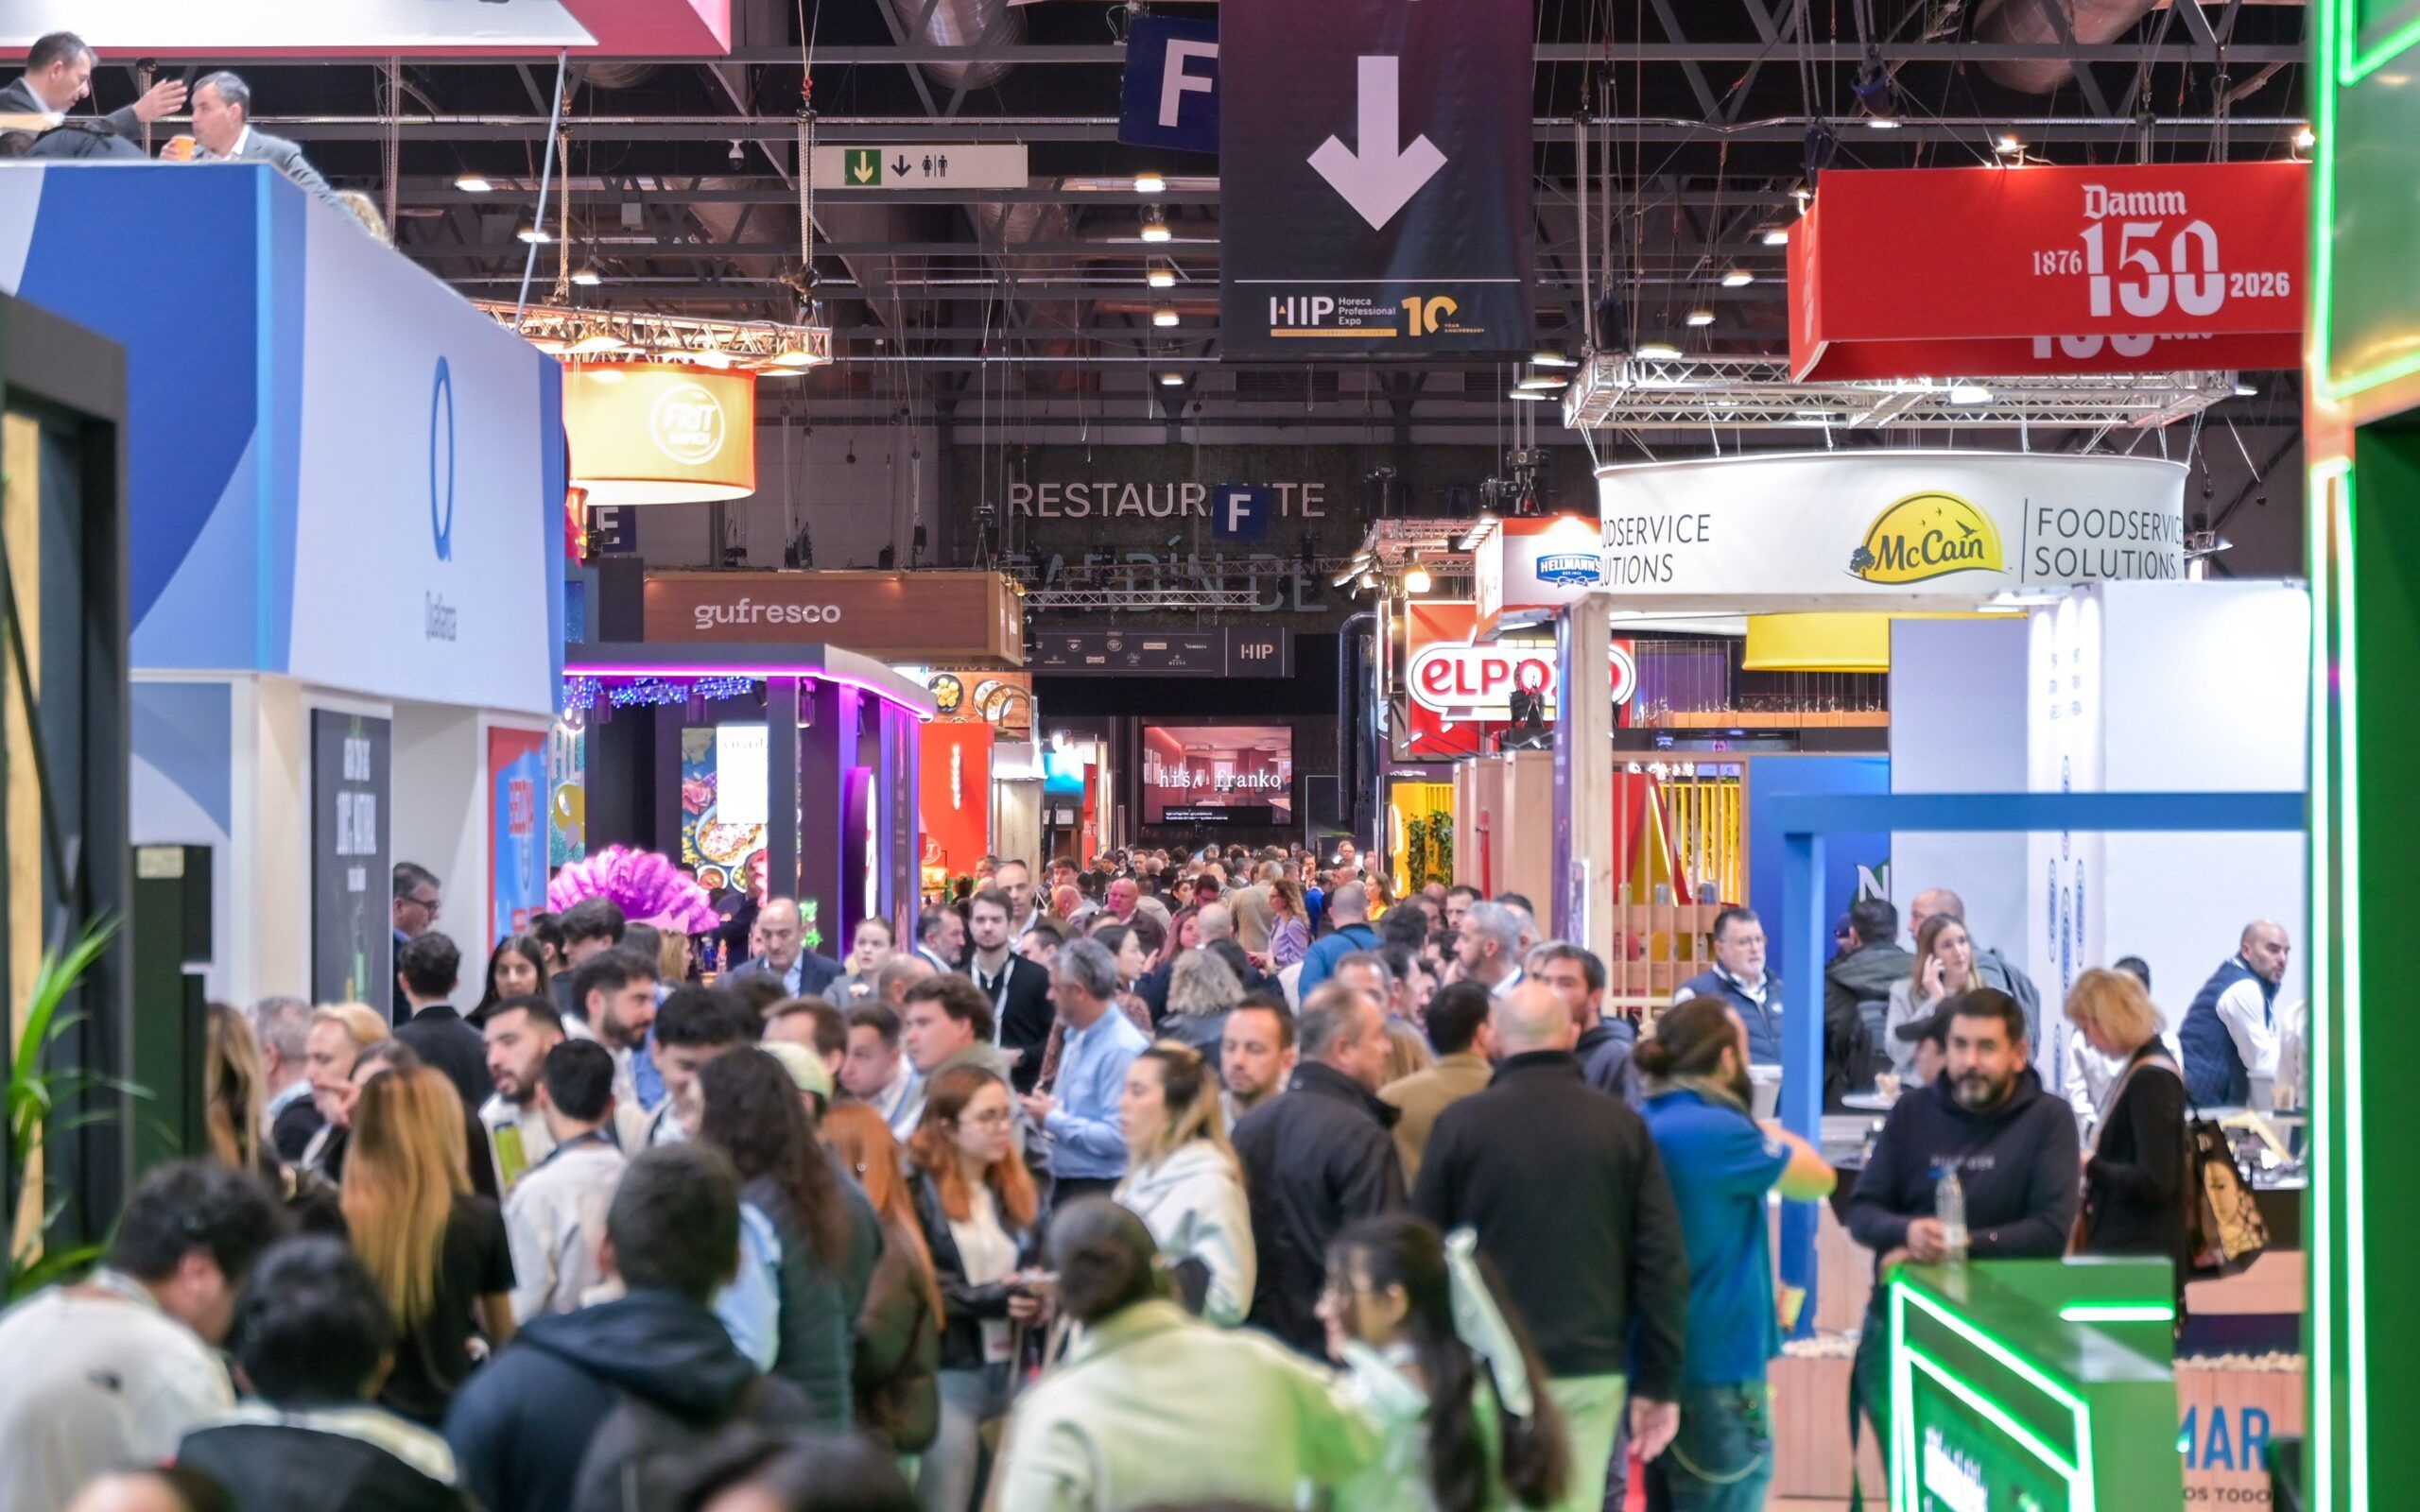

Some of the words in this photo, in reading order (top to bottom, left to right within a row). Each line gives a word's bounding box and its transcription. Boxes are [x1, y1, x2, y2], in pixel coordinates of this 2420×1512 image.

[1159, 39, 1219, 127] F
[2082, 184, 2187, 219] Damm
[2033, 250, 2083, 275] 1876
[2079, 220, 2225, 317] 150
[2231, 272, 2290, 297] 2026
[1270, 297, 1334, 325] HIP
[1339, 307, 1396, 316] Professional
[1339, 317, 1361, 326] Expo
[1009, 483, 1325, 517] RESTAURTE
[1229, 494, 1252, 531] F
[1874, 529, 1984, 571] McCain
[2034, 546, 2175, 580] SOLUTIONS
[694, 597, 841, 630] gufresco
[1240, 644, 1274, 660] HIP
[1215, 768, 1281, 788] franko
